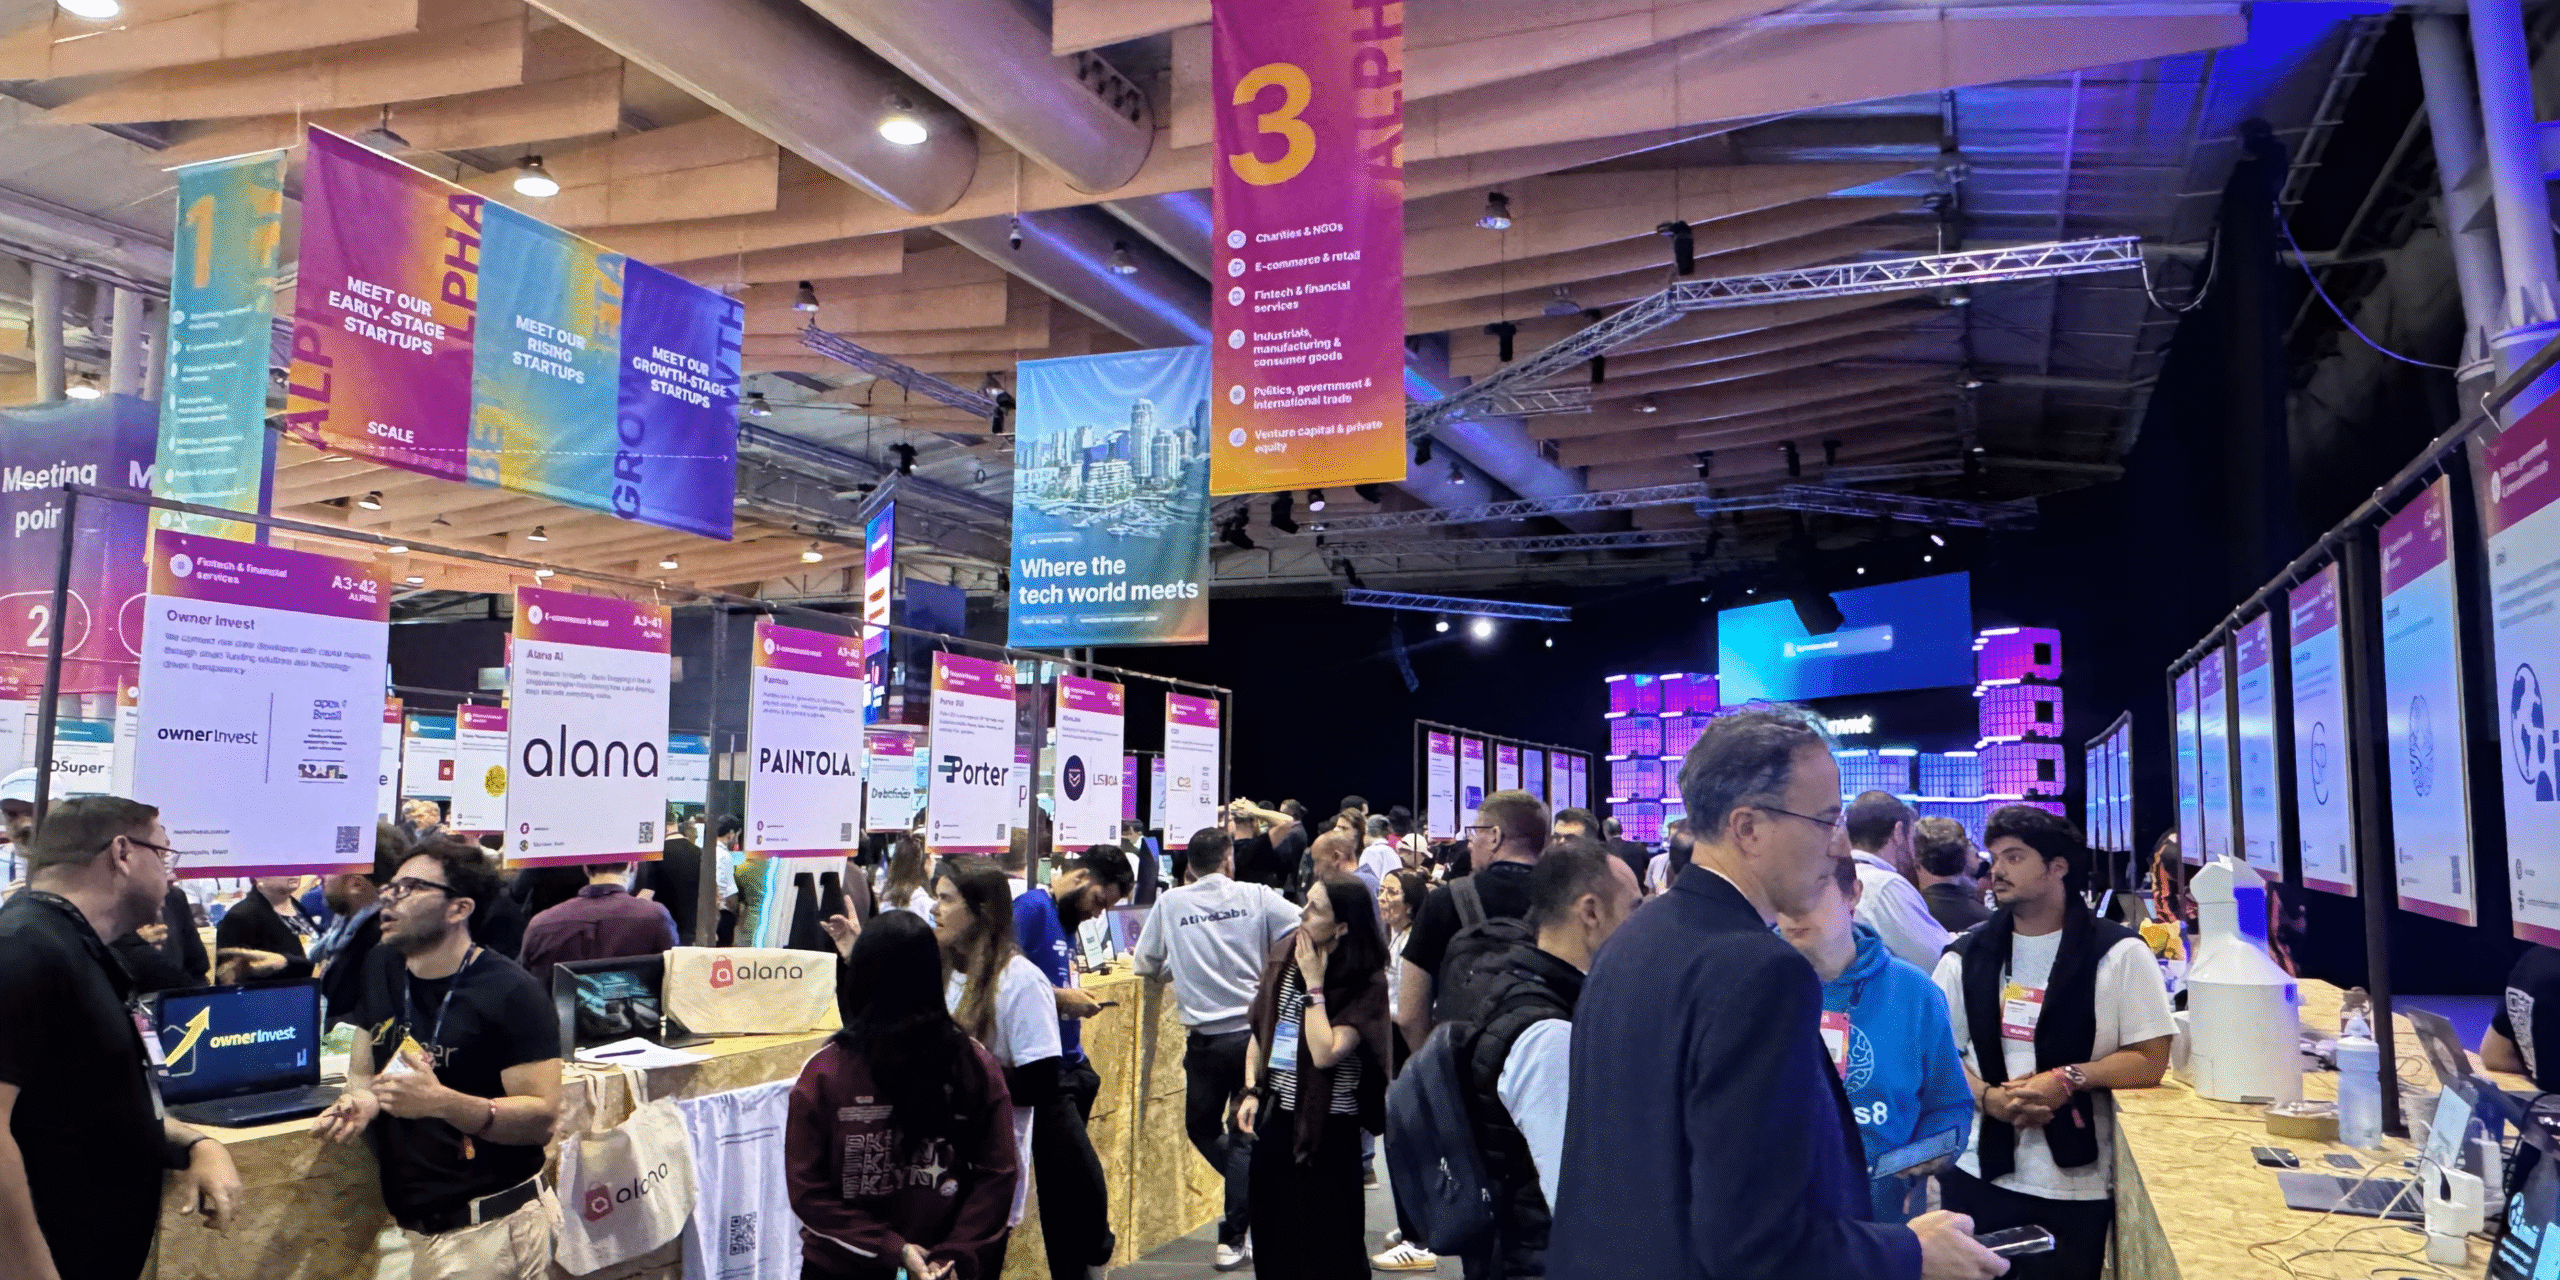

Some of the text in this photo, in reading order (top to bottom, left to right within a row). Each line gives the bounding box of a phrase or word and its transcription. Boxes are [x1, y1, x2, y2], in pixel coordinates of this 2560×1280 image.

[1229, 62, 1316, 186] 3
[185, 196, 215, 288] 1
[1256, 222, 1344, 243] Charities & NGOs
[1255, 250, 1361, 272] E-commerce & retail
[347, 275, 432, 317] MEET OUR
[1255, 281, 1350, 300] Fintech & financial
[329, 290, 445, 340] EARLY-STAGE
[1255, 301, 1299, 313] services
[344, 316, 433, 355] STARTUPS
[516, 315, 587, 351] MEET OUR
[1254, 328, 1312, 342] Industrials,
[1254, 337, 1342, 354] manufacturing &
[528, 337, 573, 363] RISING
[652, 345, 710, 377] MEET OUR
[1254, 351, 1343, 367] consumer goods
[513, 351, 585, 385] STARTUPS
[632, 357, 728, 398] GROWTH-STAGE
[651, 379, 711, 409] STARTUPS
[1254, 377, 1372, 397] Politics, government &
[1254, 393, 1352, 409] international trade
[367, 421, 414, 444] SCALE
[1255, 420, 1383, 440] Venture capital & private
[1255, 442, 1287, 454] equity
[2, 460, 97, 492] Meeting
[1020, 555, 1126, 578] Where the
[331, 575, 378, 594] A3-42
[1018, 579, 1199, 604] tech world meets
[166, 609, 255, 630] Owner Invest
[523, 724, 658, 778] alana
[760, 747, 856, 776] PAINTOLA.
[938, 754, 1009, 787] Porter
[736, 960, 803, 982] alana
[615, 1162, 669, 1204] alana
